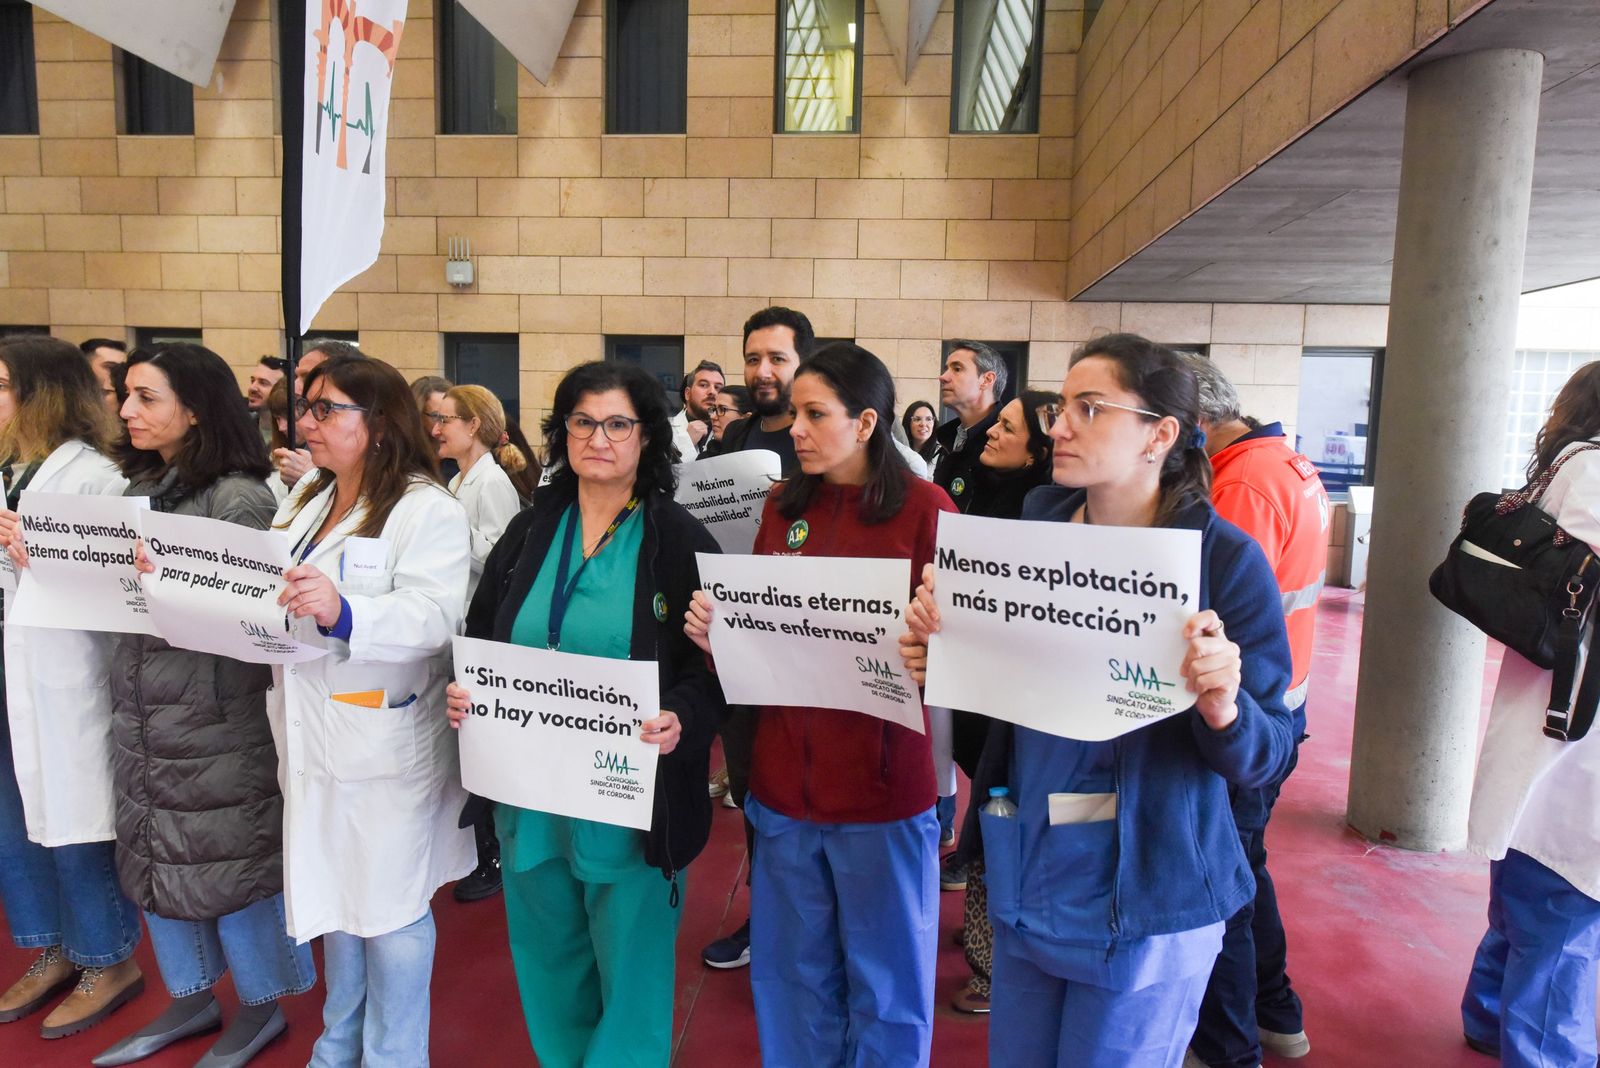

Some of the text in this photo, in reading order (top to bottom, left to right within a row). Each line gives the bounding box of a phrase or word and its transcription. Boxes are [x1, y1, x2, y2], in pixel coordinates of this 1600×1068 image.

[691, 478, 735, 493] “Máxima
[740, 486, 772, 502] mínim
[20, 515, 70, 534] Médico
[25, 541, 69, 560] istema
[73, 545, 138, 567] colapsad
[145, 536, 283, 577] “Queremos descansar
[160, 567, 276, 599] para poder curar”
[934, 545, 1189, 606] Menos explotación,
[703, 582, 900, 619] “Guardias eternas,
[952, 589, 1157, 637] más protección”
[724, 612, 886, 645] vidas enfermas”
[464, 666, 639, 711] “Sin conciliación,
[1106, 694, 1147, 710] SINDICATO
[494, 698, 534, 727] hay
[539, 711, 642, 737] vocación”
[590, 779, 645, 795] SINDICATO MÉDICO
[606, 790, 636, 801] CÓRDOBA
